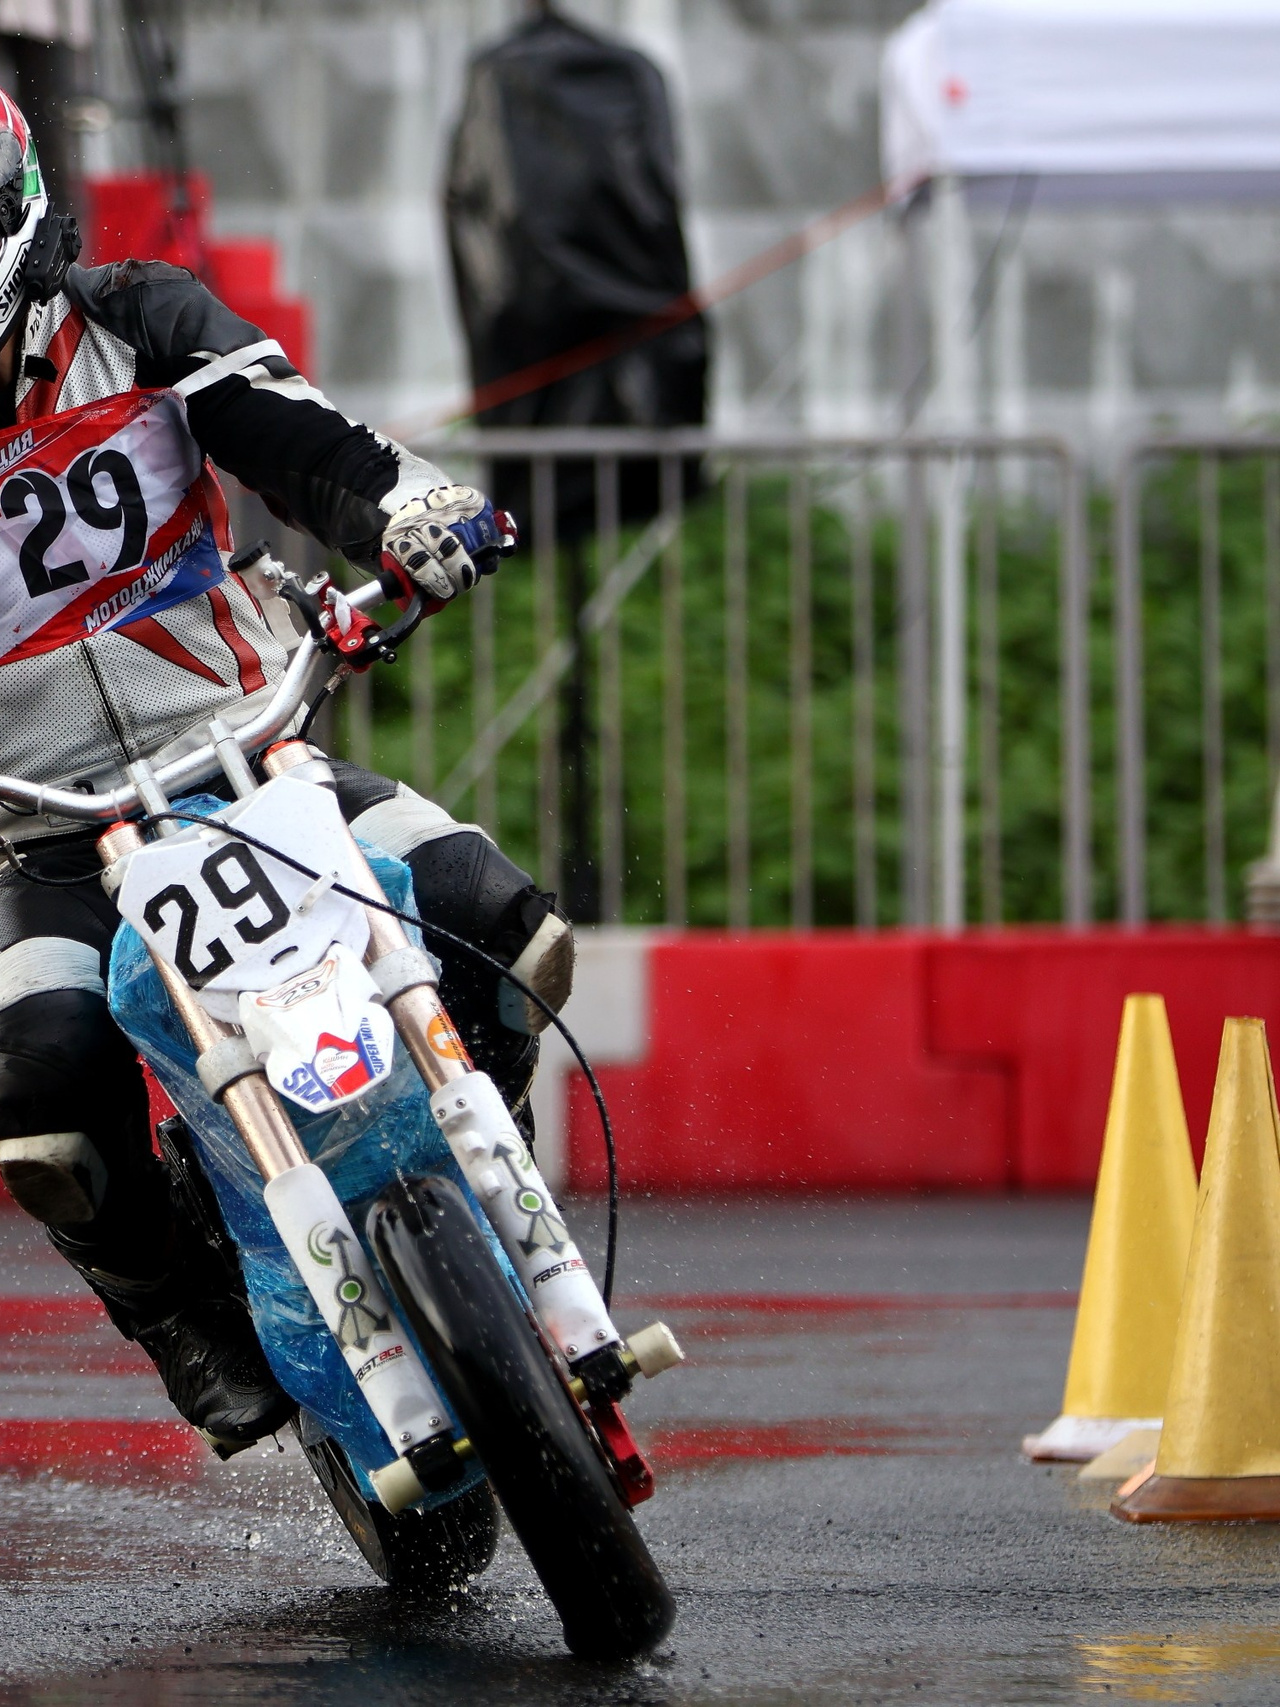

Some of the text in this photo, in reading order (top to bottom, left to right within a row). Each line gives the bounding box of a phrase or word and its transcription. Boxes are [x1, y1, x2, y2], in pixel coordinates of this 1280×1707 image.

[0, 448, 148, 599] 29
[84, 511, 205, 634] МОТОДЖИМХАНЫ
[143, 842, 291, 992] 29
[281, 980, 321, 1005] 29
[282, 1067, 326, 1105] SM
[365, 1043, 386, 1074] SUPER
